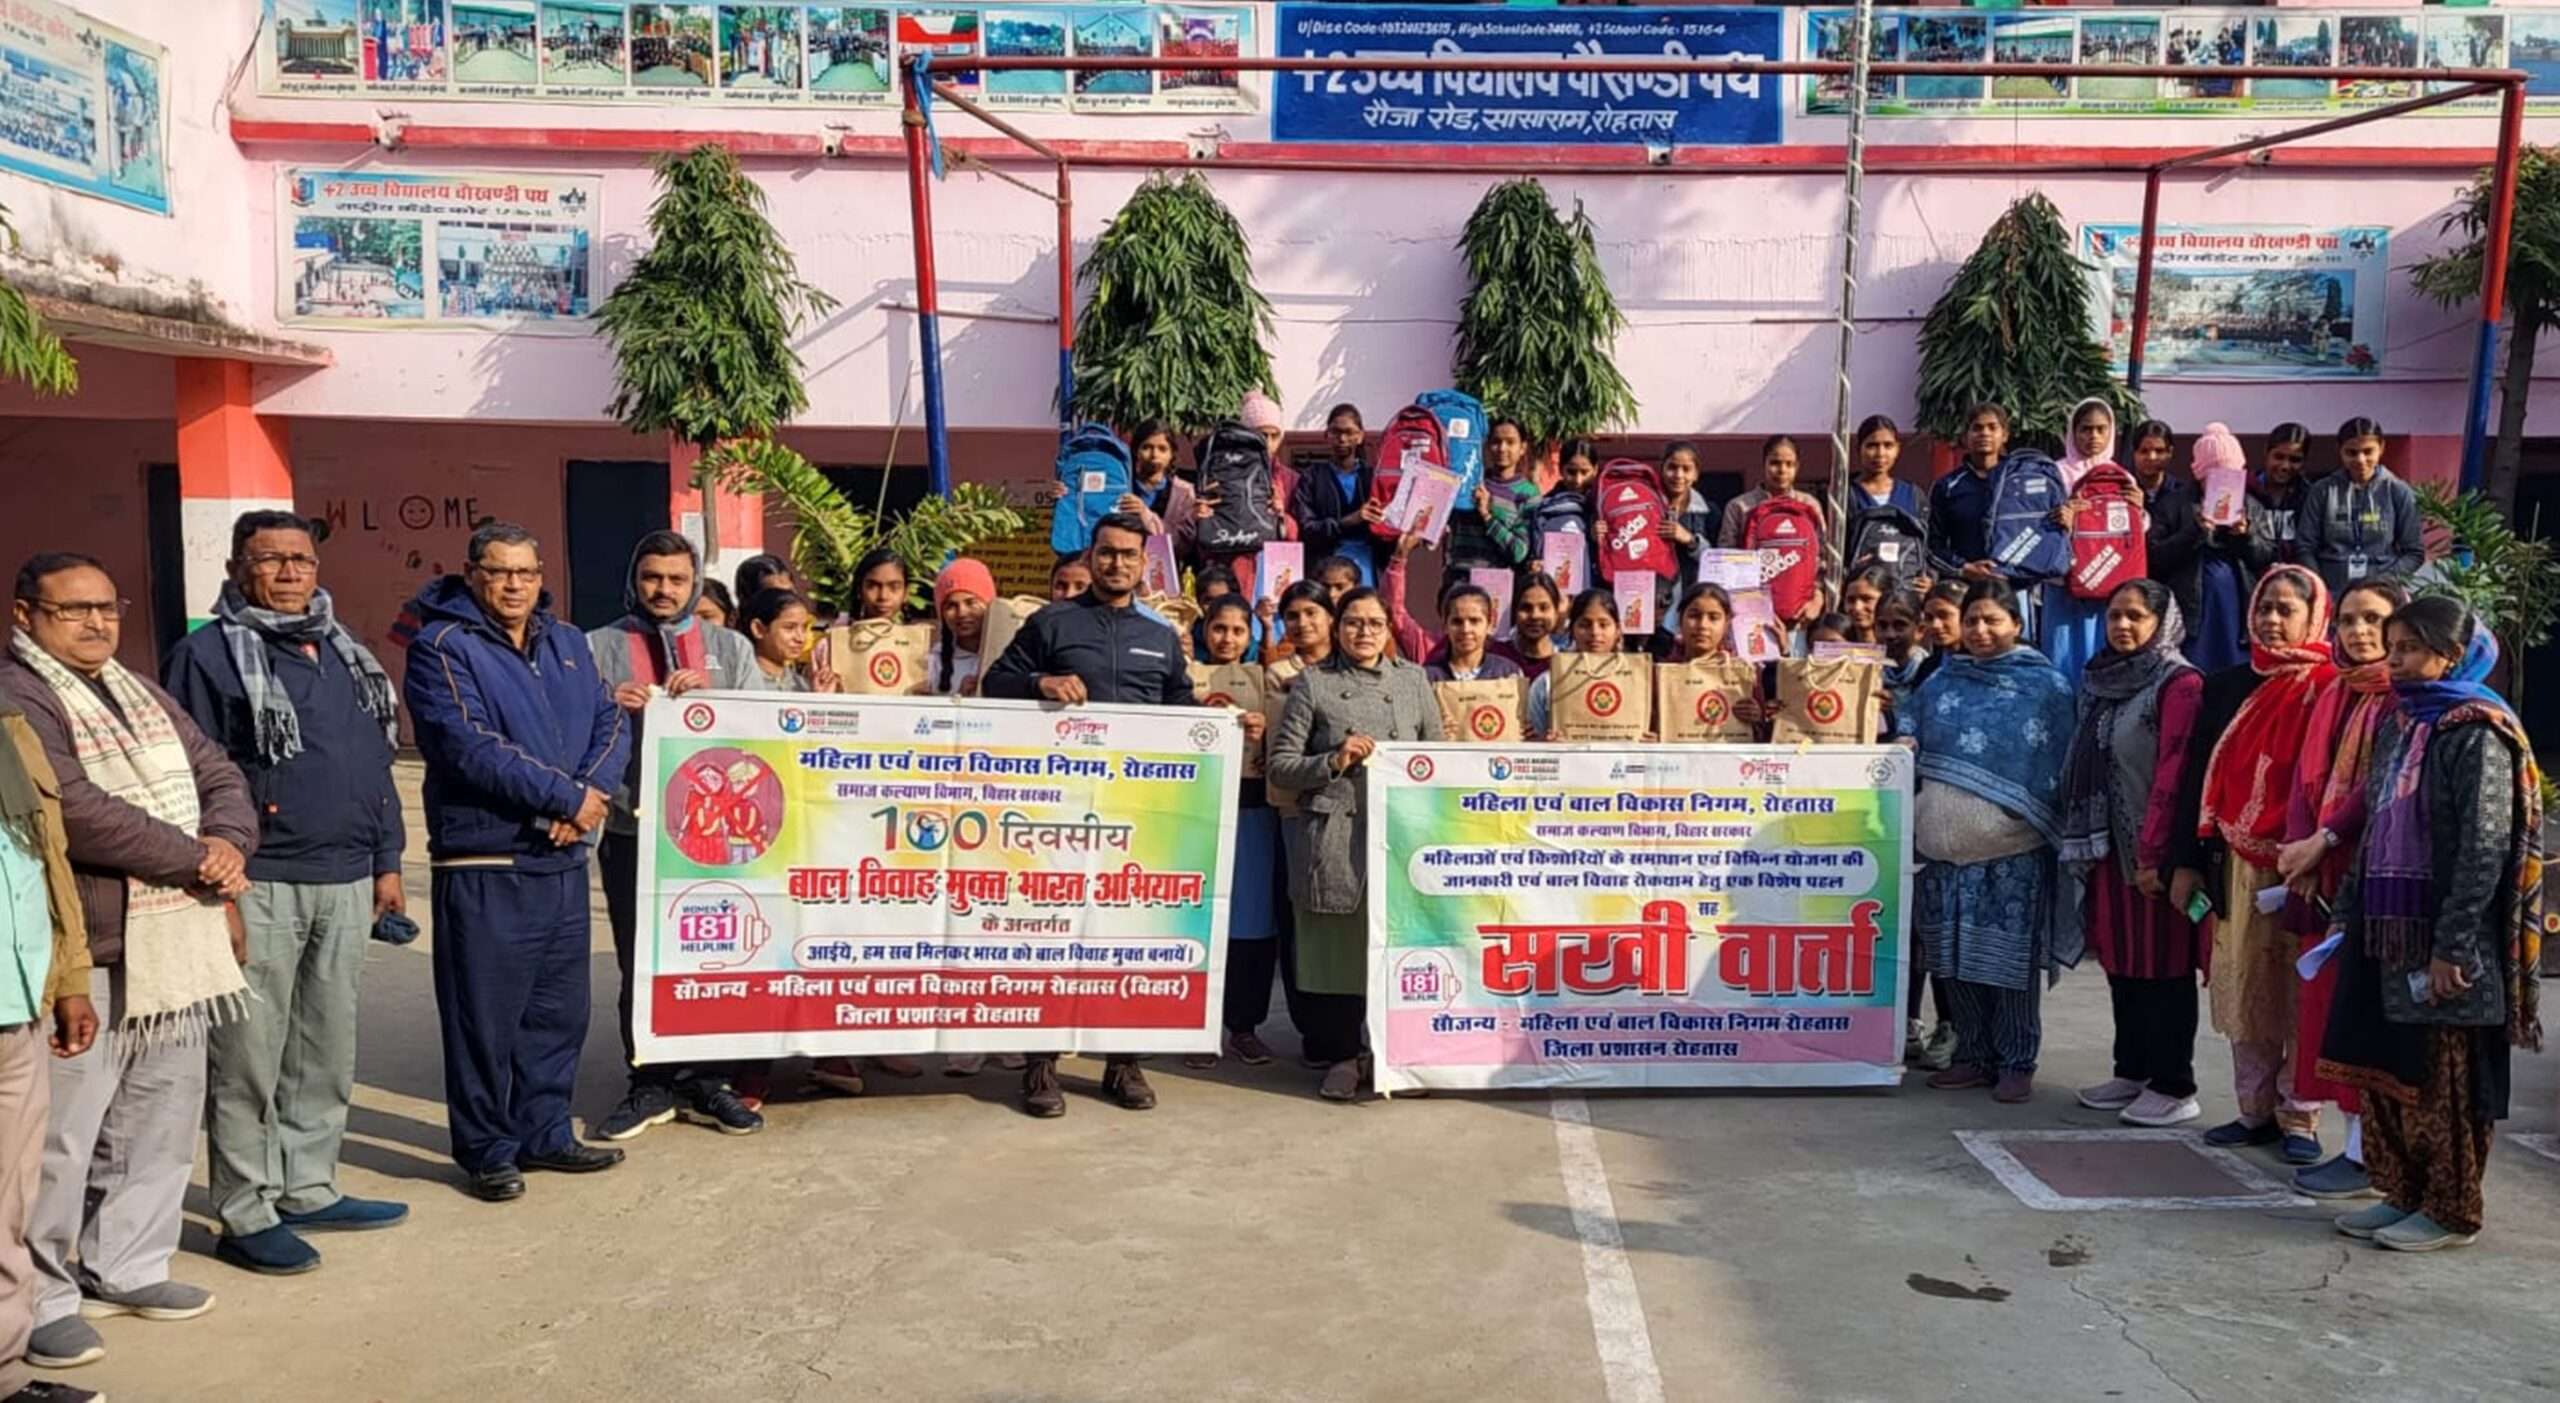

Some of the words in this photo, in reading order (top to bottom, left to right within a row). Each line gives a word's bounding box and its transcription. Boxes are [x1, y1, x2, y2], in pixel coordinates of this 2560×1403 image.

[799, 747, 872, 770] महिला
[878, 750, 914, 770] एवं
[969, 752, 1040, 774] विकास
[1047, 754, 1116, 779] निगम,
[1123, 756, 1197, 780] रोहतास
[837, 783, 879, 798] समाज
[880, 784, 932, 799] कल्याण
[1019, 789, 1062, 803] सरकार
[1462, 792, 1528, 812] महिला
[1533, 794, 1564, 812] एवं
[1616, 792, 1684, 812] विकास
[1691, 793, 1756, 815] निगम,
[1763, 793, 1835, 813] रोहतास
[999, 810, 1133, 853] दिवसीय
[1424, 848, 1497, 866] महिलाओं
[1501, 850, 1524, 866] एवं
[1609, 849, 1625, 865] के
[1697, 850, 1721, 866] एवं
[1784, 850, 1838, 867] योजना
[1841, 849, 1864, 866] की
[788, 868, 850, 904] बाल
[858, 857, 940, 904] विवाह
[944, 868, 1009, 915] मुक्त
[1017, 870, 1088, 905] भारत
[1094, 862, 1204, 908] अभियान
[1443, 871, 1514, 888] जानकारी
[1518, 871, 1541, 887] एवं
[1583, 871, 1629, 888] विवाह
[1633, 873, 1694, 889] रोकथाम
[1698, 872, 1722, 891] हेतु
[1725, 875, 1755, 889] एक
[1805, 875, 1845, 889] पहल
[1697, 901, 1720, 917] सह
[681, 916, 735, 940] 181
[981, 913, 999, 932] के
[1003, 914, 1071, 932] अन्तर्गत
[681, 941, 735, 953] HELPLINE
[862, 944, 885, 961] हम
[889, 945, 912, 961] सब
[916, 942, 970, 961] मिलकर
[973, 946, 1008, 962] भारत
[1011, 942, 1032, 962] को
[1036, 946, 1065, 962] बाल
[1069, 942, 1108, 962] विवाह
[1112, 947, 1144, 965] मुक्त
[1476, 899, 1698, 998] सखी
[1715, 899, 1884, 998] वार्ता
[673, 978, 749, 1001] सौजन्य
[767, 975, 833, 997] महिला
[839, 975, 872, 996] एवं
[875, 978, 916, 996] बाल
[921, 974, 985, 996] विकास
[991, 975, 1045, 996] निगम
[1050, 975, 1116, 996] रोहतास
[1402, 974, 1439, 992] 181
[835, 1003, 890, 1025] जिला
[896, 1004, 967, 1025] प्रशासन
[973, 1003, 1042, 1024] रोहतास
[1432, 1013, 1497, 1031] सौजन्य
[1520, 1012, 1579, 1031] महिला
[1584, 1012, 1614, 1031] एवं
[1617, 1015, 1655, 1030] बाल
[1660, 1011, 1723, 1031] विकास
[1727, 1012, 1781, 1031] निगम
[1784, 1013, 1851, 1031] रोहतास
[1543, 1039, 1593, 1057] जिला
[1600, 1041, 1667, 1057] प्रशासन
[1671, 1038, 1739, 1057] रोहतास
